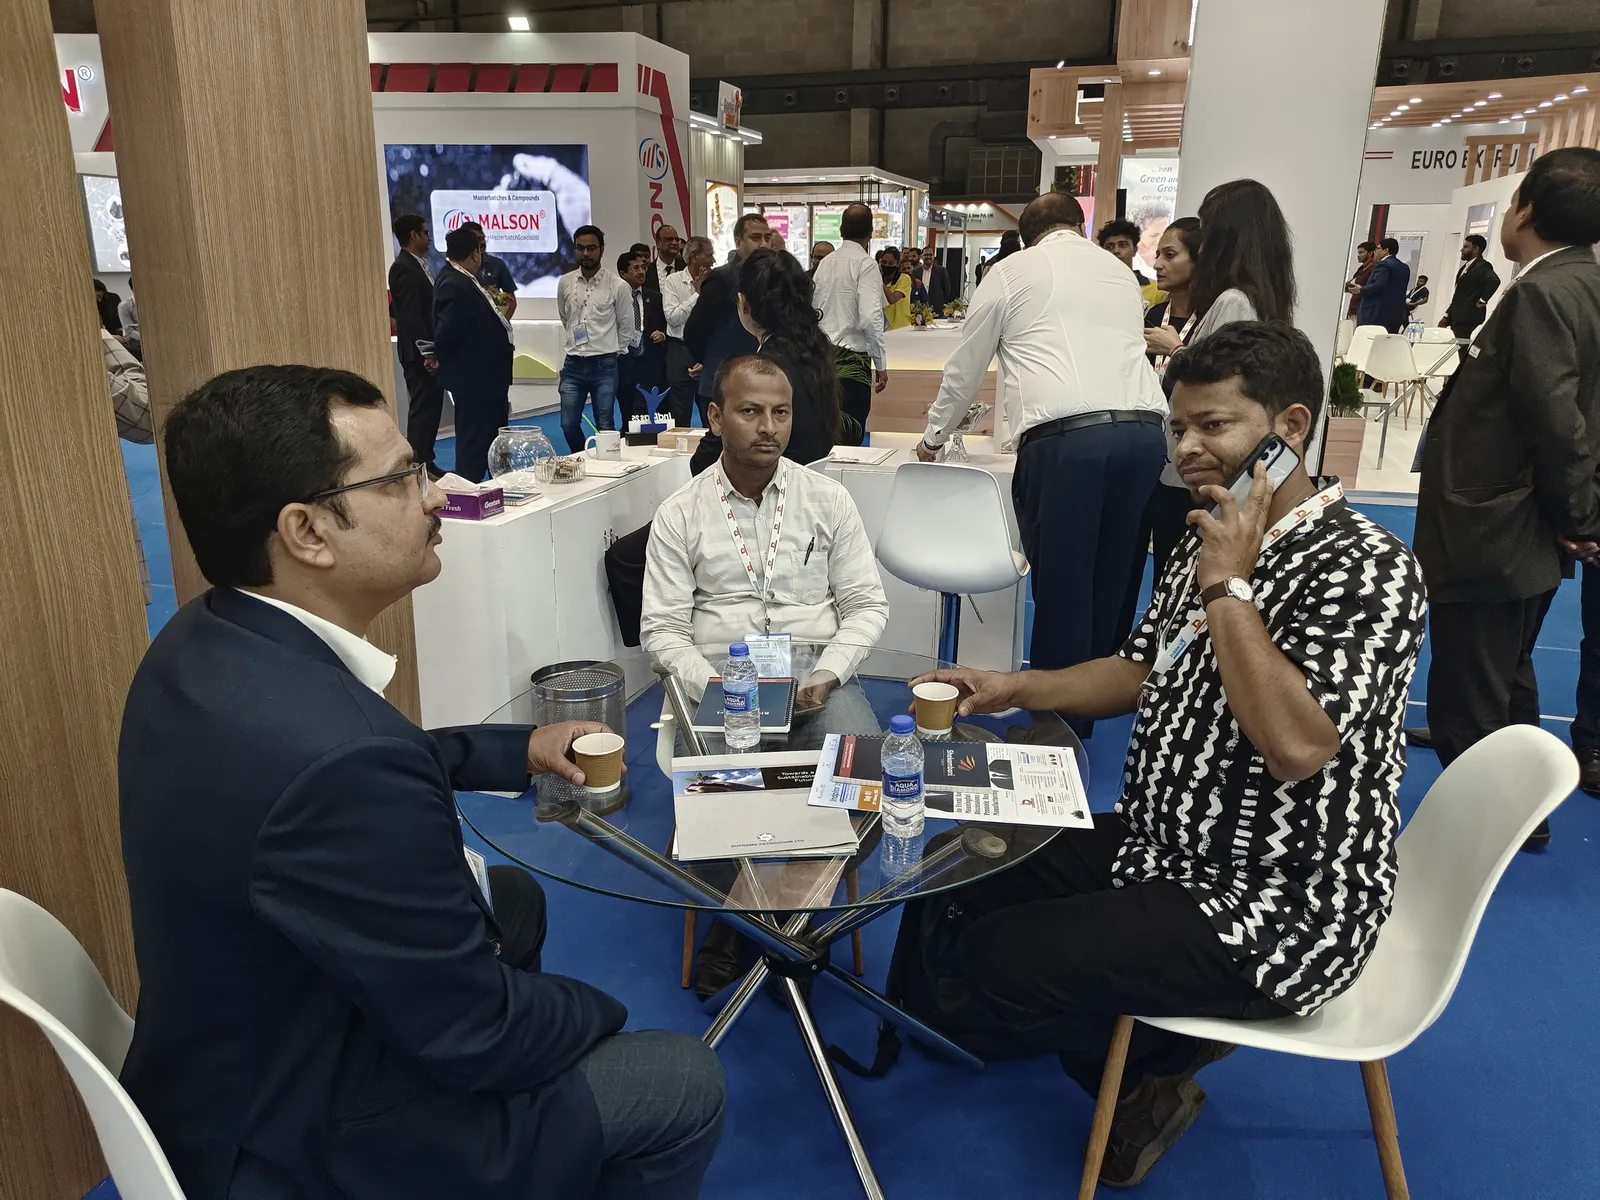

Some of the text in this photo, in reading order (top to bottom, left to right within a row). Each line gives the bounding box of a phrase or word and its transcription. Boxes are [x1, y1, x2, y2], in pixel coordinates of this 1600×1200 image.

[1411, 150, 1457, 169] EURO
[1139, 174, 1167, 183] Green
[890, 784, 919, 793] DIAMOND
